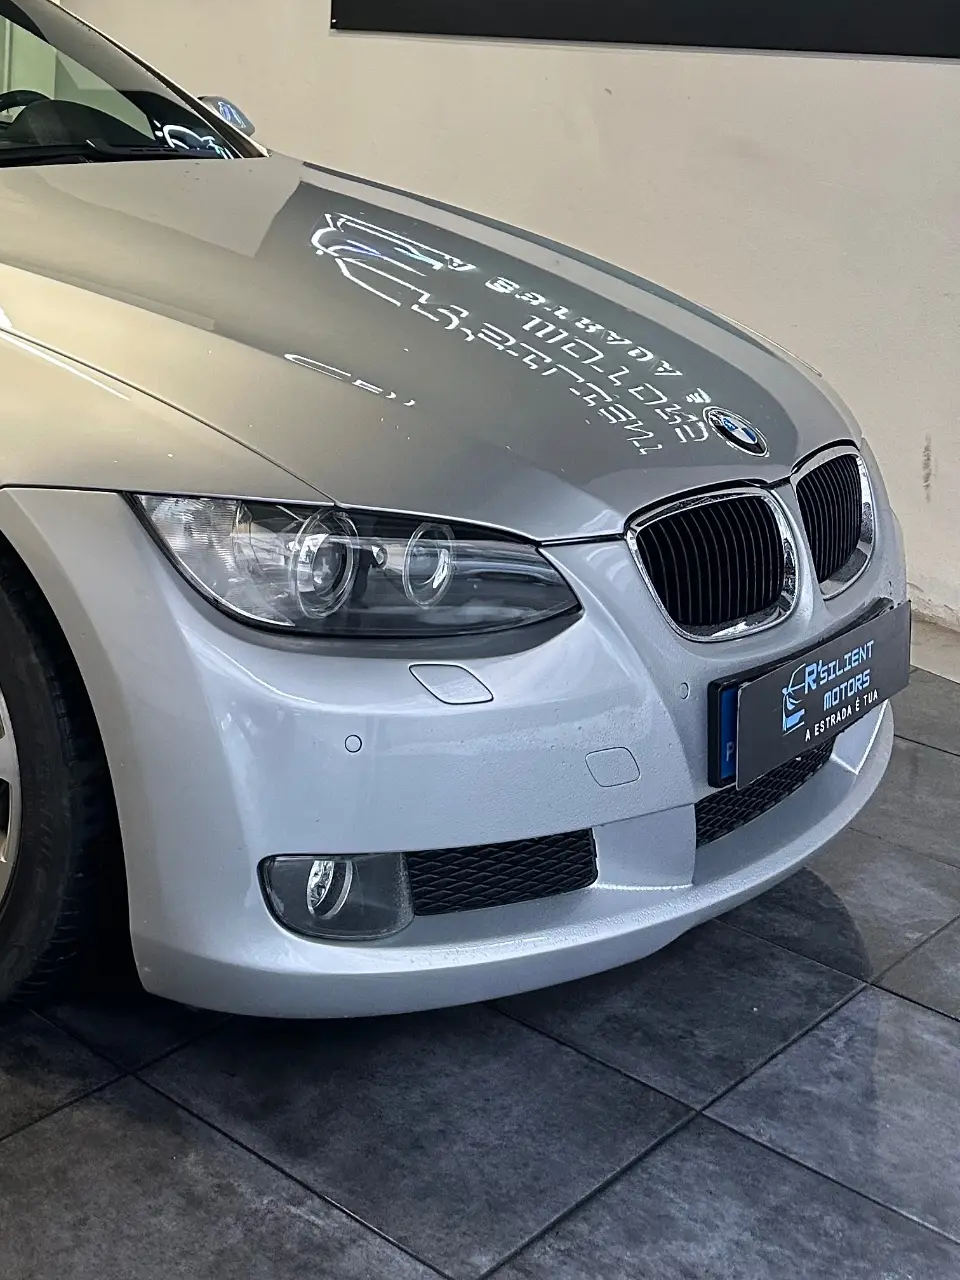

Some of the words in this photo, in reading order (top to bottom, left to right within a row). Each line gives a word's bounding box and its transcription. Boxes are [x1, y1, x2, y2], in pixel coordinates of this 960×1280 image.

[804, 639, 875, 694] R'SILIENT
[823, 669, 871, 711] MOTORS
[805, 729, 811, 742] A
[814, 706, 852, 735] ESTRADA
[855, 696, 861, 711] É
[863, 689, 878, 706] TUA
[726, 741, 734, 762] P
